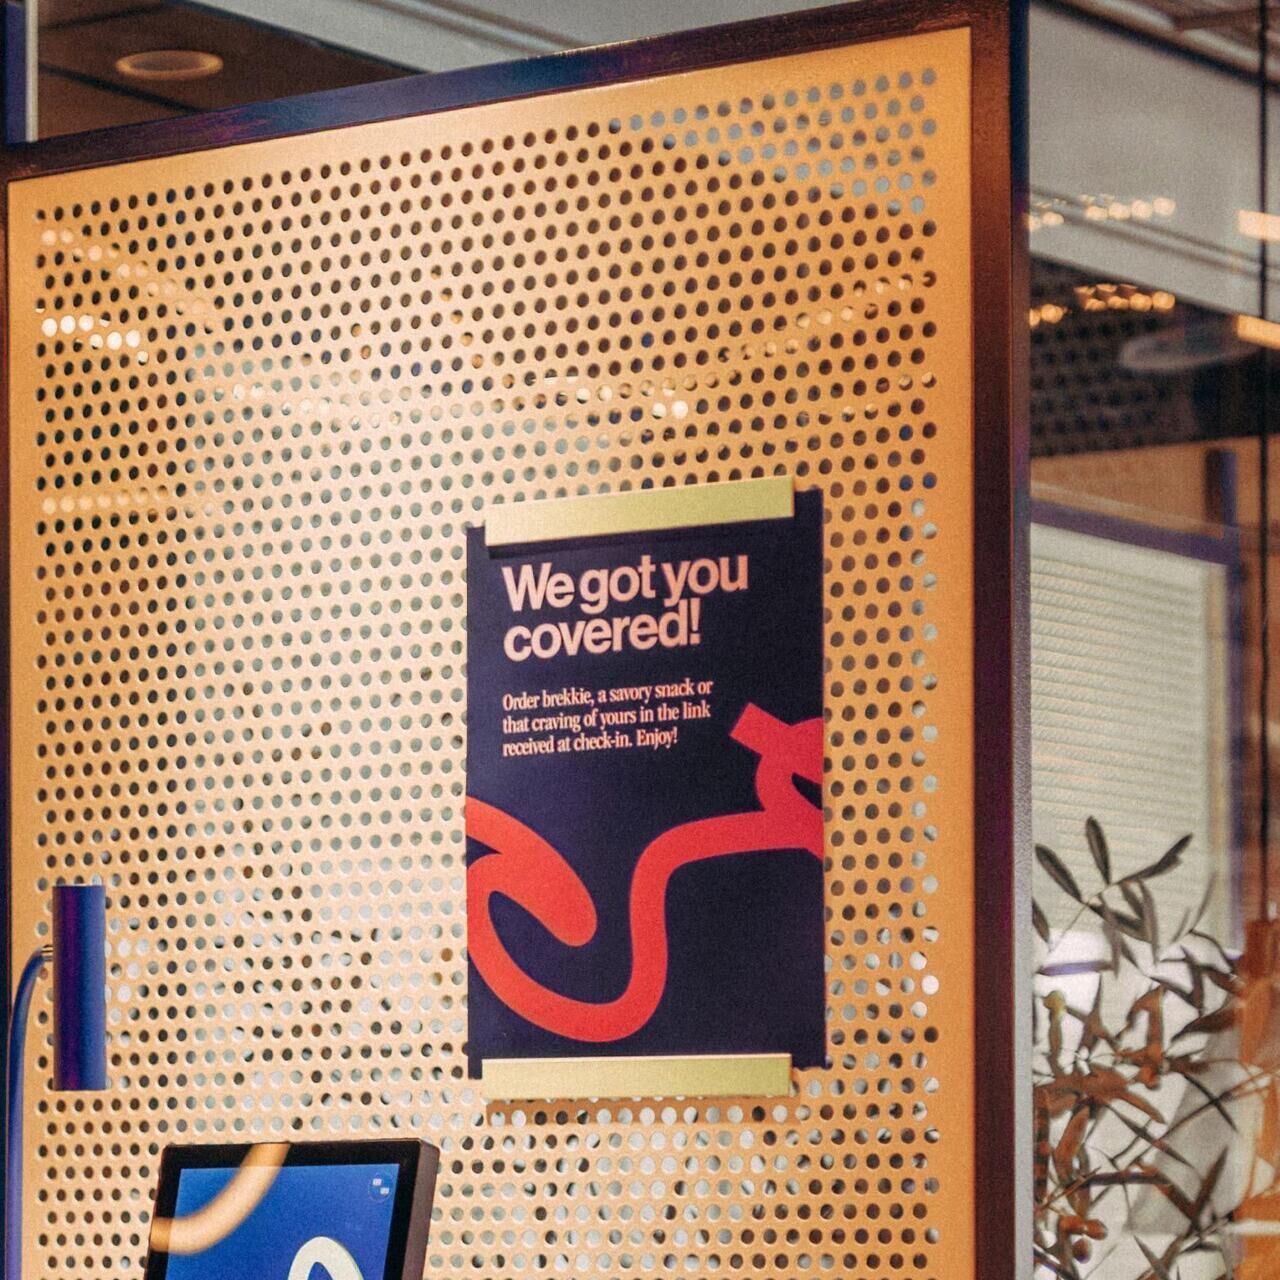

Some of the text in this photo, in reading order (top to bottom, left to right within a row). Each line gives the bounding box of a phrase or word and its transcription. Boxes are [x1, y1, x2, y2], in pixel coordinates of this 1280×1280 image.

[501, 554, 750, 615] We got you
[503, 597, 702, 663] covered!
[502, 677, 714, 711] Order brekkie, a savory snack or
[502, 699, 712, 734] that craving of yours in the link
[502, 726, 679, 758] received at check-in. Enjoy!
